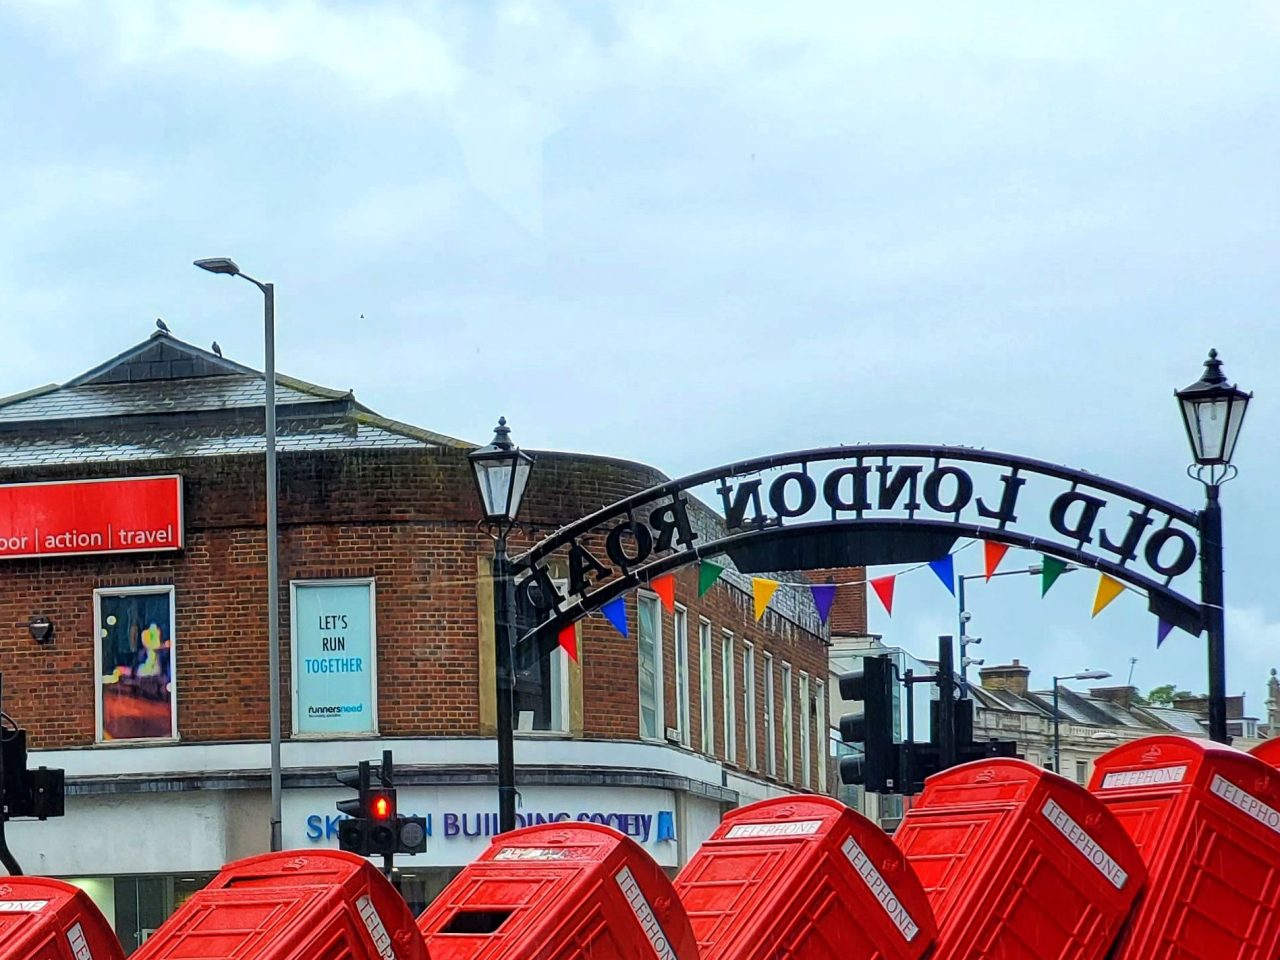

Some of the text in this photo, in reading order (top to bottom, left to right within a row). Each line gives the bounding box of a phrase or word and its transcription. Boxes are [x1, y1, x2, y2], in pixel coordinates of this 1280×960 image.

[44, 530, 103, 549] action
[118, 524, 172, 545] travel
[318, 614, 348, 631] LET'S
[322, 637, 346, 652] RUN
[305, 658, 363, 674] TOGETHER
[308, 702, 363, 714] runnersneed
[1106, 767, 1184, 788] TELEPHONE
[1215, 777, 1280, 828] TELEPHO
[732, 822, 819, 837] TELEPHONE
[1047, 801, 1124, 885] TELEPHONE
[846, 839, 915, 938] TELEPHONE
